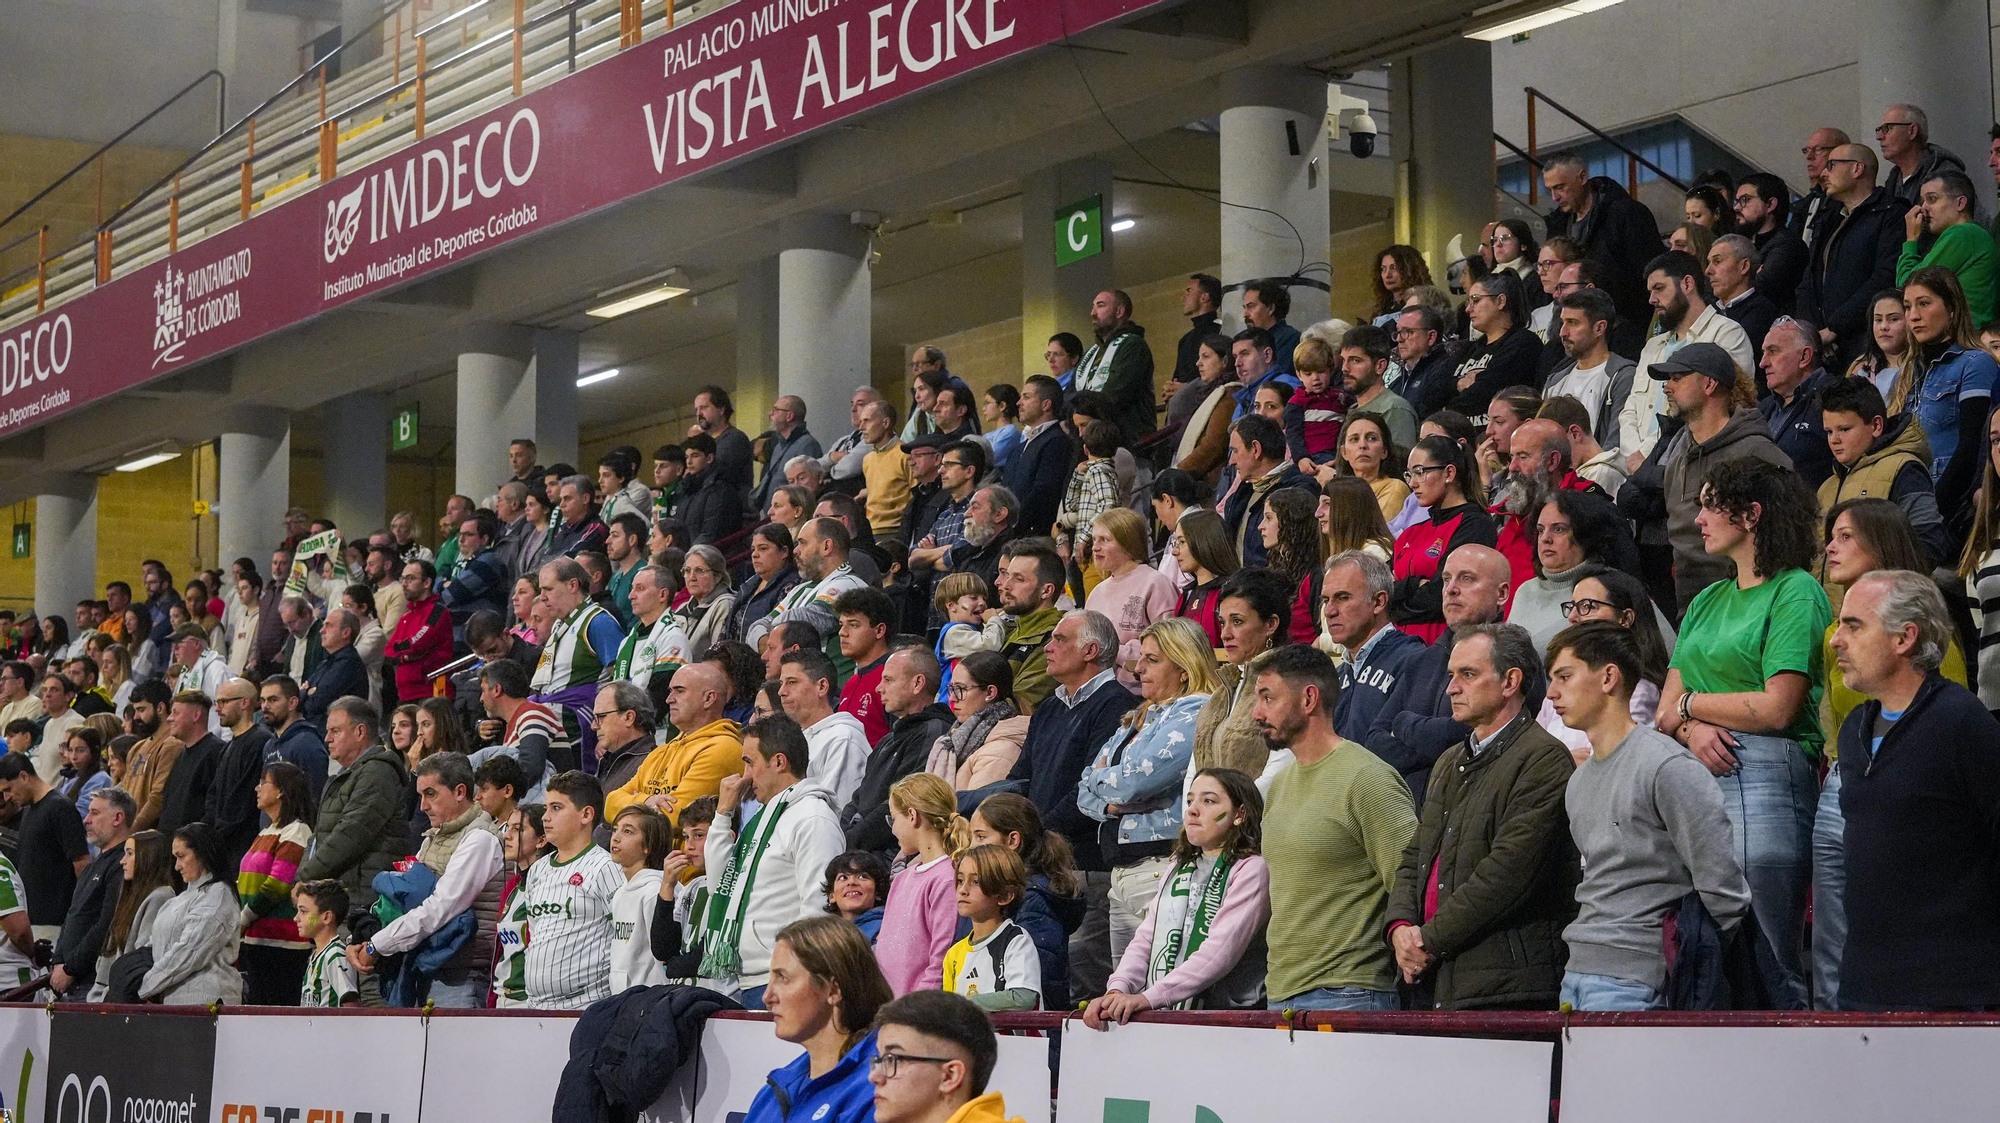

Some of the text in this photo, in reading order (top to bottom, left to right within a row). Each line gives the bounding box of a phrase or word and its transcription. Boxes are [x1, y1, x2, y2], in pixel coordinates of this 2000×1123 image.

[664, 17, 746, 78] PALACIO
[642, 0, 1017, 175] VISTA ALEGRE
[369, 107, 541, 245] IMDECO
[324, 203, 538, 301] Instituto Municipal de Deportes Córdoba
[1067, 210, 1088, 252] C
[186, 247, 252, 303] AYUNTAMIENTO
[185, 289, 241, 339] DE CÓRDOBA
[9, 401, 40, 426] Deportes
[40, 387, 71, 413] Córdoba
[399, 411, 410, 441] B
[16, 530, 24, 553] A
